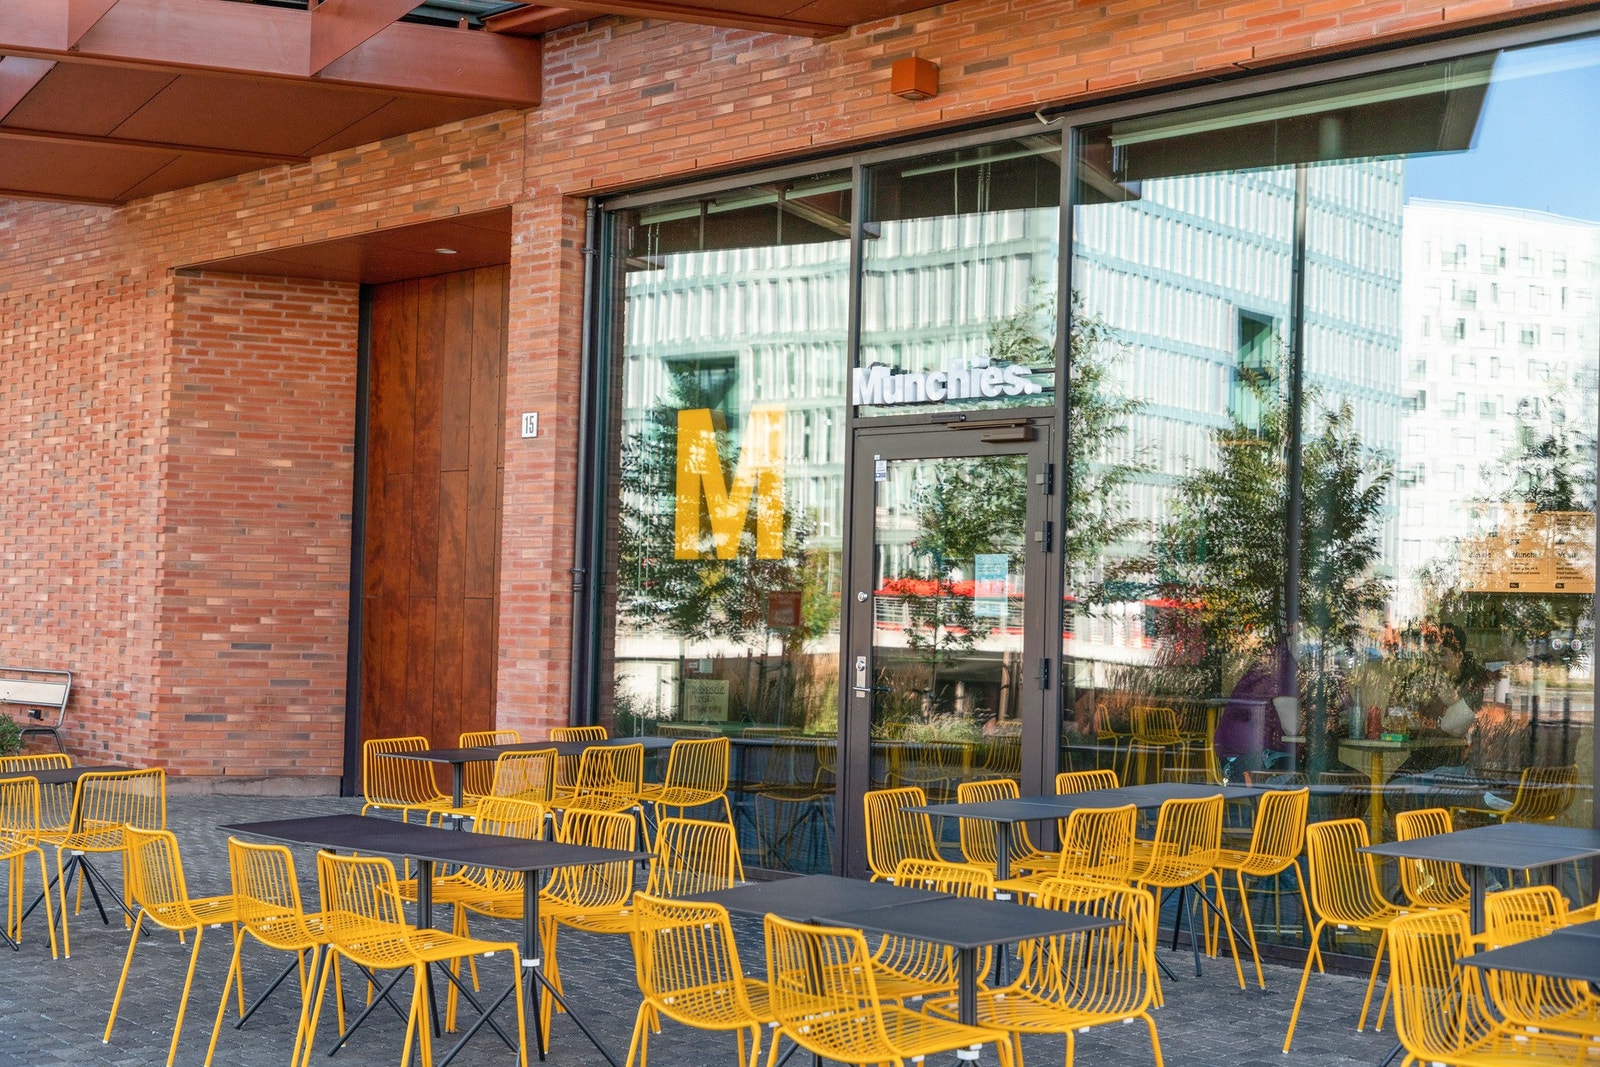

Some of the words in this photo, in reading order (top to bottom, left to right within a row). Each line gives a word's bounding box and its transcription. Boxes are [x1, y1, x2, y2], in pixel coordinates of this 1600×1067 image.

[853, 356, 1042, 405] Munchies.
[525, 415, 535, 434] 15
[674, 403, 787, 560] M
